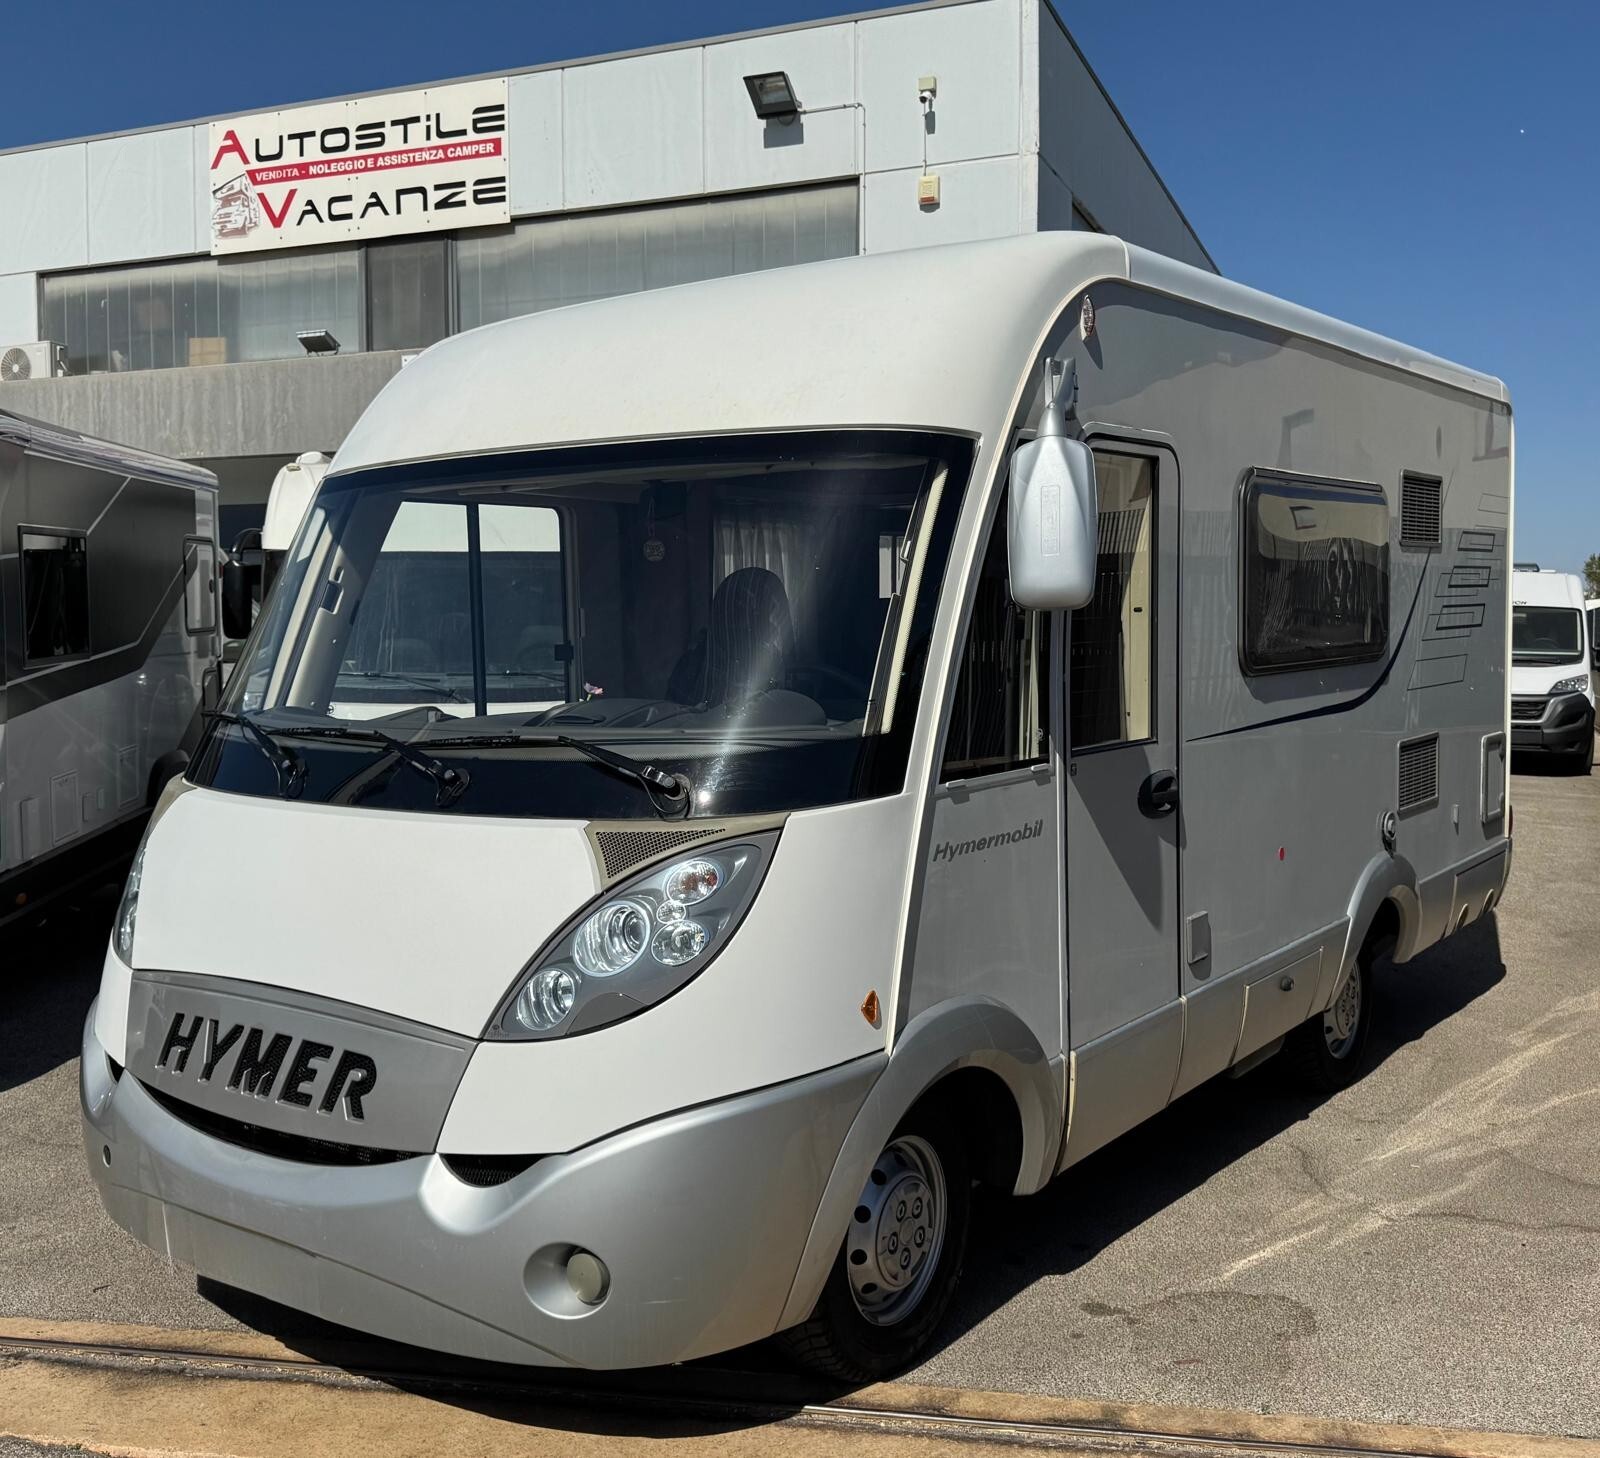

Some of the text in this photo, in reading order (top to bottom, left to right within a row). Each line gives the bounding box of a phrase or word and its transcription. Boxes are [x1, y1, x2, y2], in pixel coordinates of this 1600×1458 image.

[255, 168, 300, 182] VENDITA
[308, 158, 366, 176] NOLEGGIO
[367, 158, 375, 168] E
[377, 149, 445, 166] ASSISTENZA
[447, 142, 495, 157] CAMPER
[932, 819, 1043, 862] Hymermobil
[155, 1013, 377, 1121] HYMER
